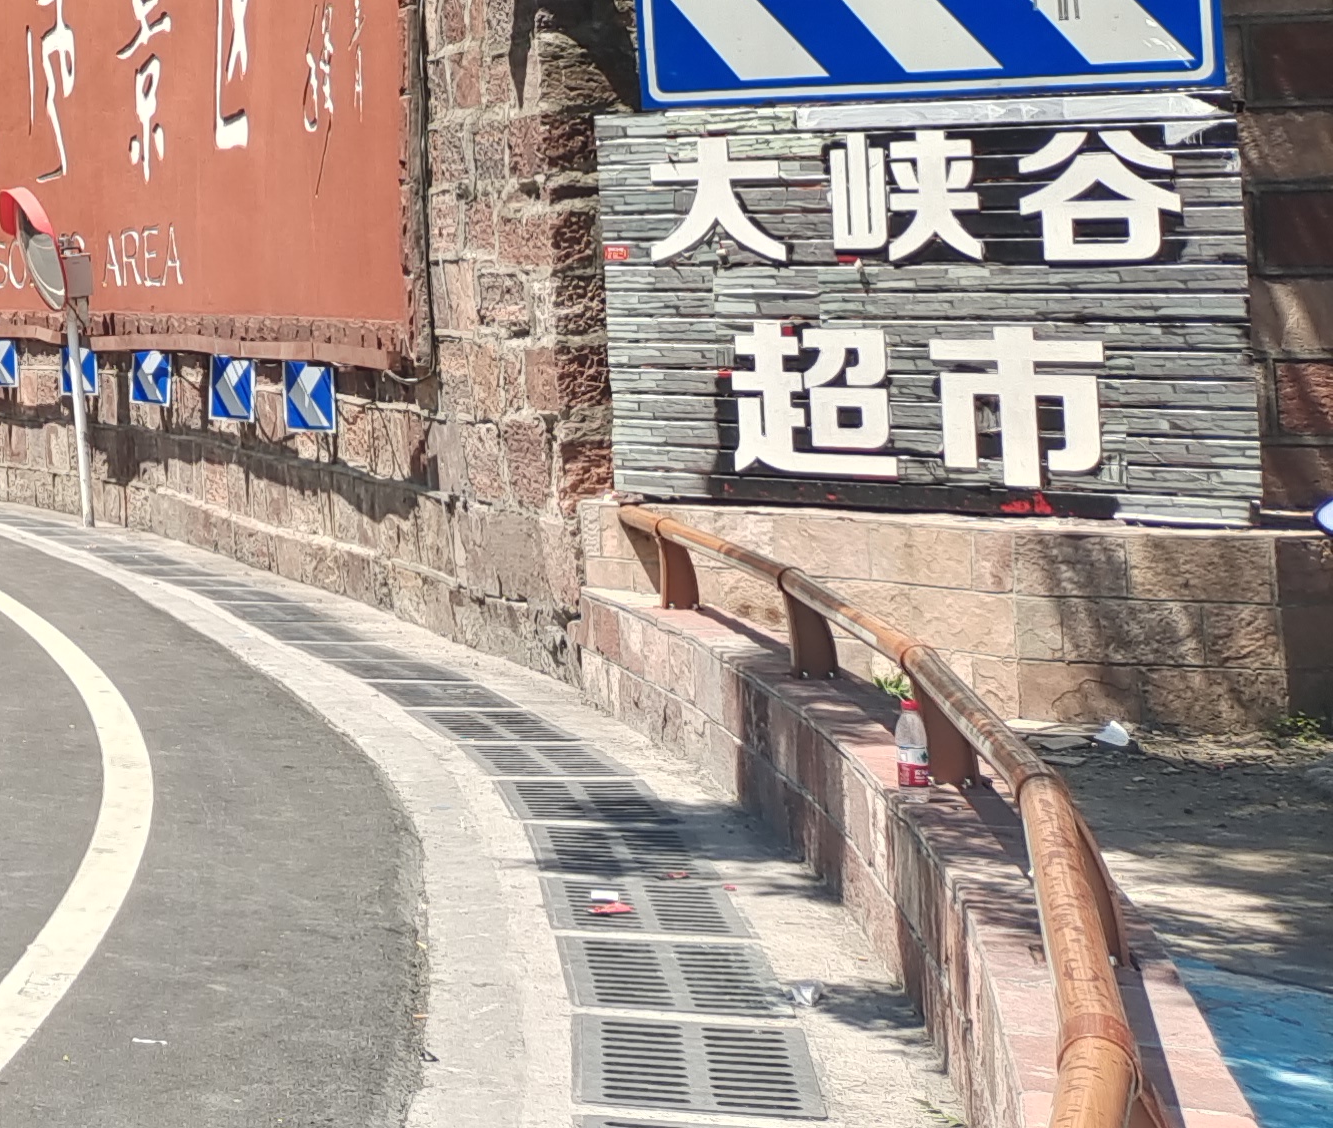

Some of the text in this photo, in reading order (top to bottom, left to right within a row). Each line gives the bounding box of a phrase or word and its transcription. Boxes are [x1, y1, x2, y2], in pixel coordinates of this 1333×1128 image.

[102, 223, 185, 288] AREA
[650, 129, 1183, 263] 大峡谷
[733, 322, 1105, 488] 超市
